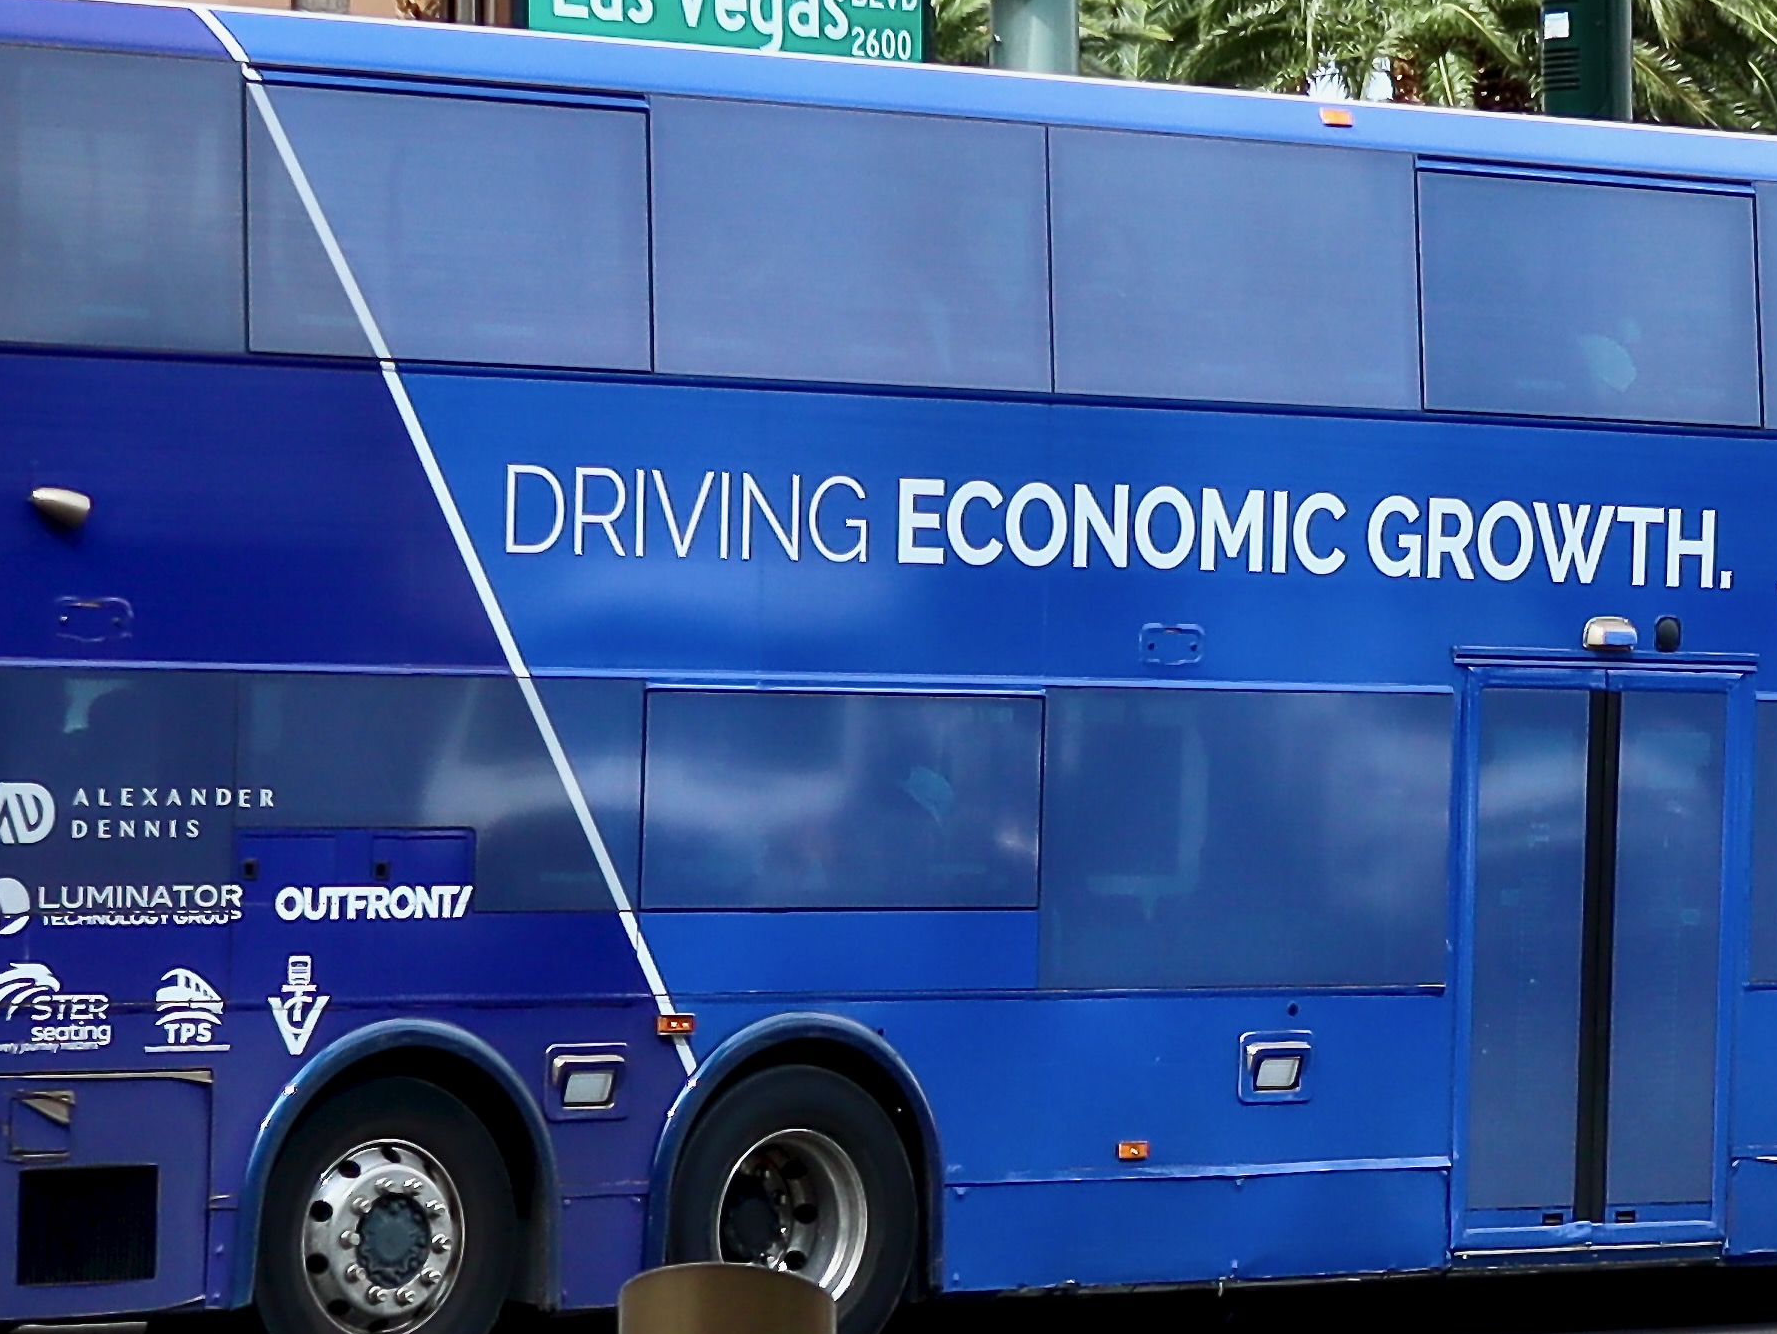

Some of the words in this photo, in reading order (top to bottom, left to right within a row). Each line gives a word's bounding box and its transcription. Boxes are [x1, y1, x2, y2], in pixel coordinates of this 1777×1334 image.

[851, 26, 912, 60] 2600
[505, 464, 869, 563] DRIVING
[898, 478, 1347, 575] ECONOMIC
[1367, 495, 1732, 589] GROWTH.
[73, 788, 274, 807] ALEXANDER
[72, 819, 199, 839] DENNIS
[38, 884, 244, 909] LUMINATOR
[43, 911, 169, 927] TECHNOLOGY
[173, 910, 242, 925] GROUP
[31, 995, 109, 1020] STER
[31, 1021, 111, 1045] seating
[163, 1024, 212, 1043] TPS
